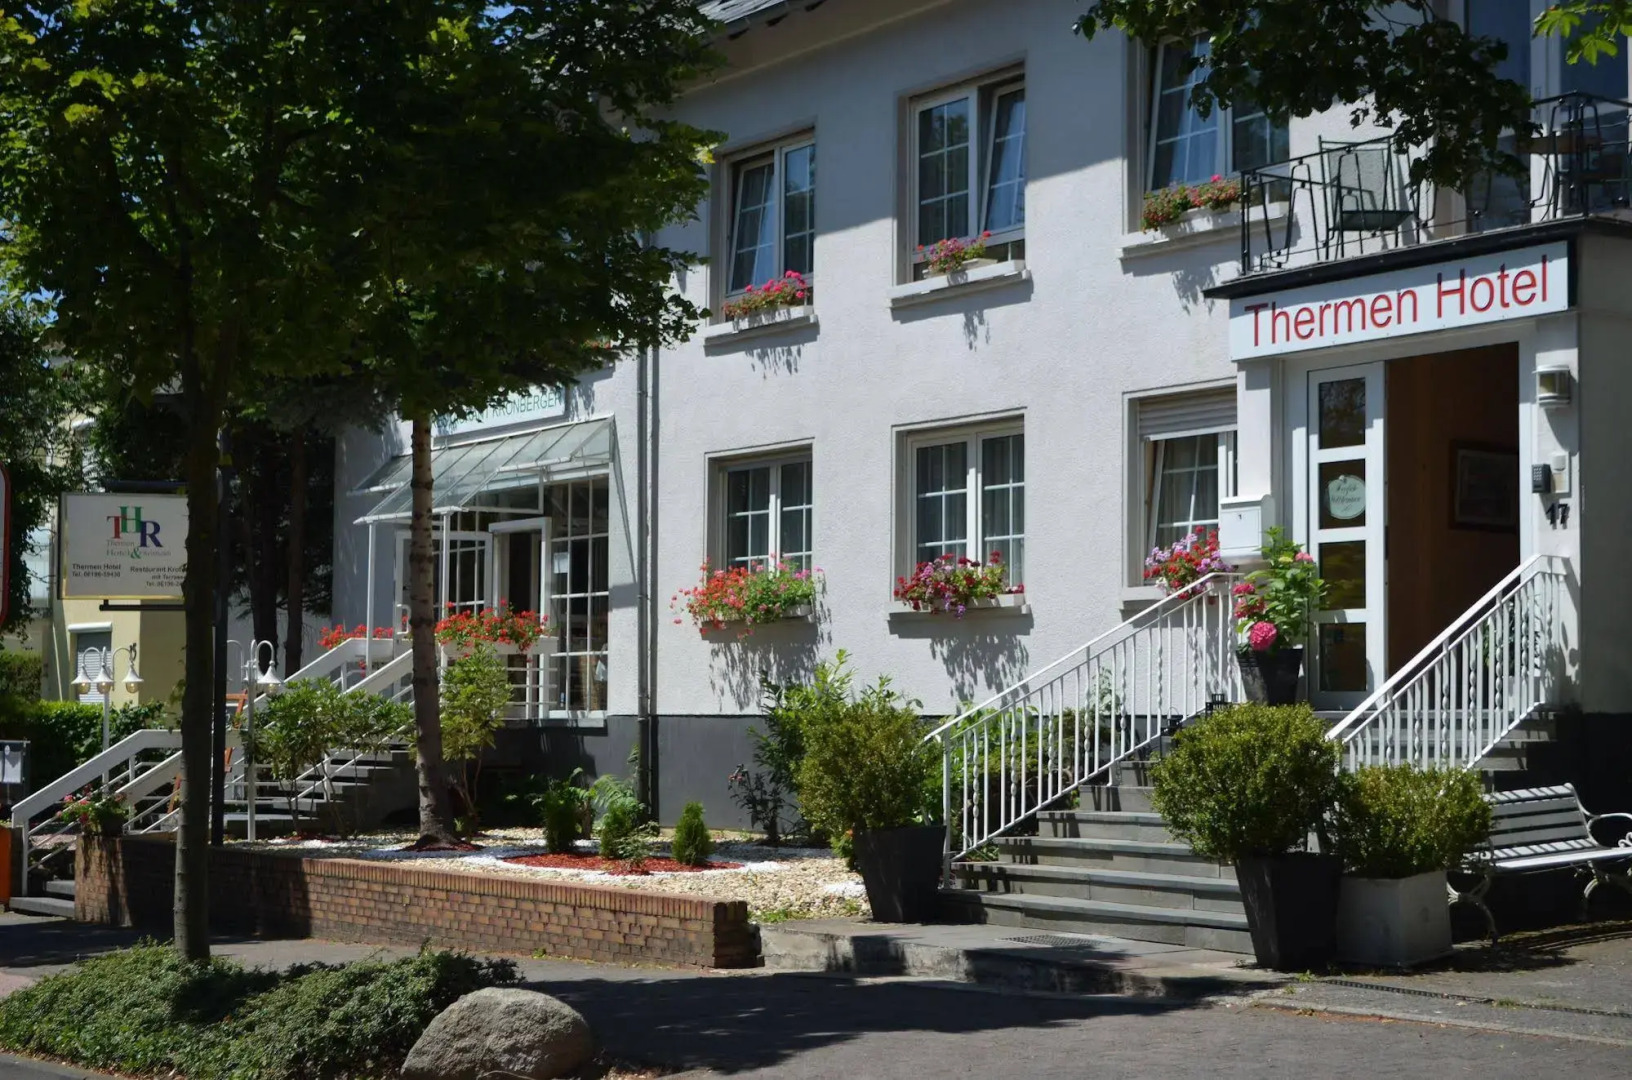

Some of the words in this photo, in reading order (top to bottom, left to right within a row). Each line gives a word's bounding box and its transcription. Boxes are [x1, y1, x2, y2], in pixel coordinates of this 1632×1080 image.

[1244, 287, 1417, 347] Thermen
[1436, 254, 1548, 319] Hotel
[1545, 502, 1568, 525] 17
